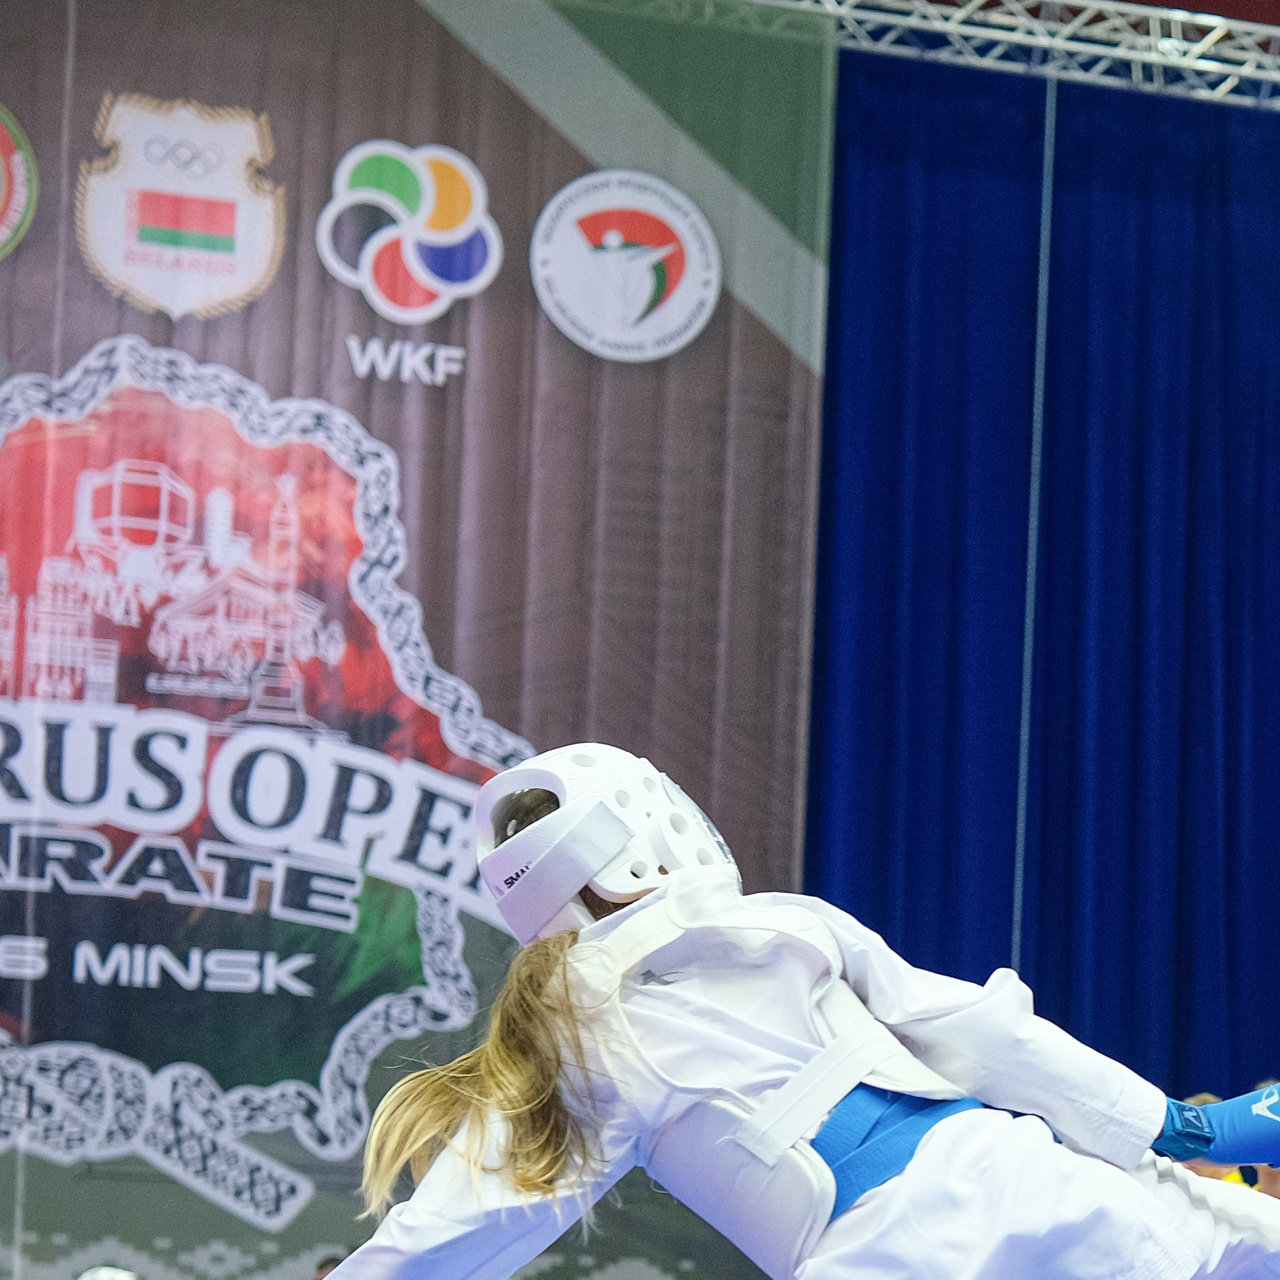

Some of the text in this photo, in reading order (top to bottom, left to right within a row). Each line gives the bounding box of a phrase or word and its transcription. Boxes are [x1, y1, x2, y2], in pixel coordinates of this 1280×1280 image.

[346, 333, 466, 388] WKF
[228, 748, 482, 892] OPE
[0, 832, 354, 920] RATE
[73, 941, 315, 996] MINSK
